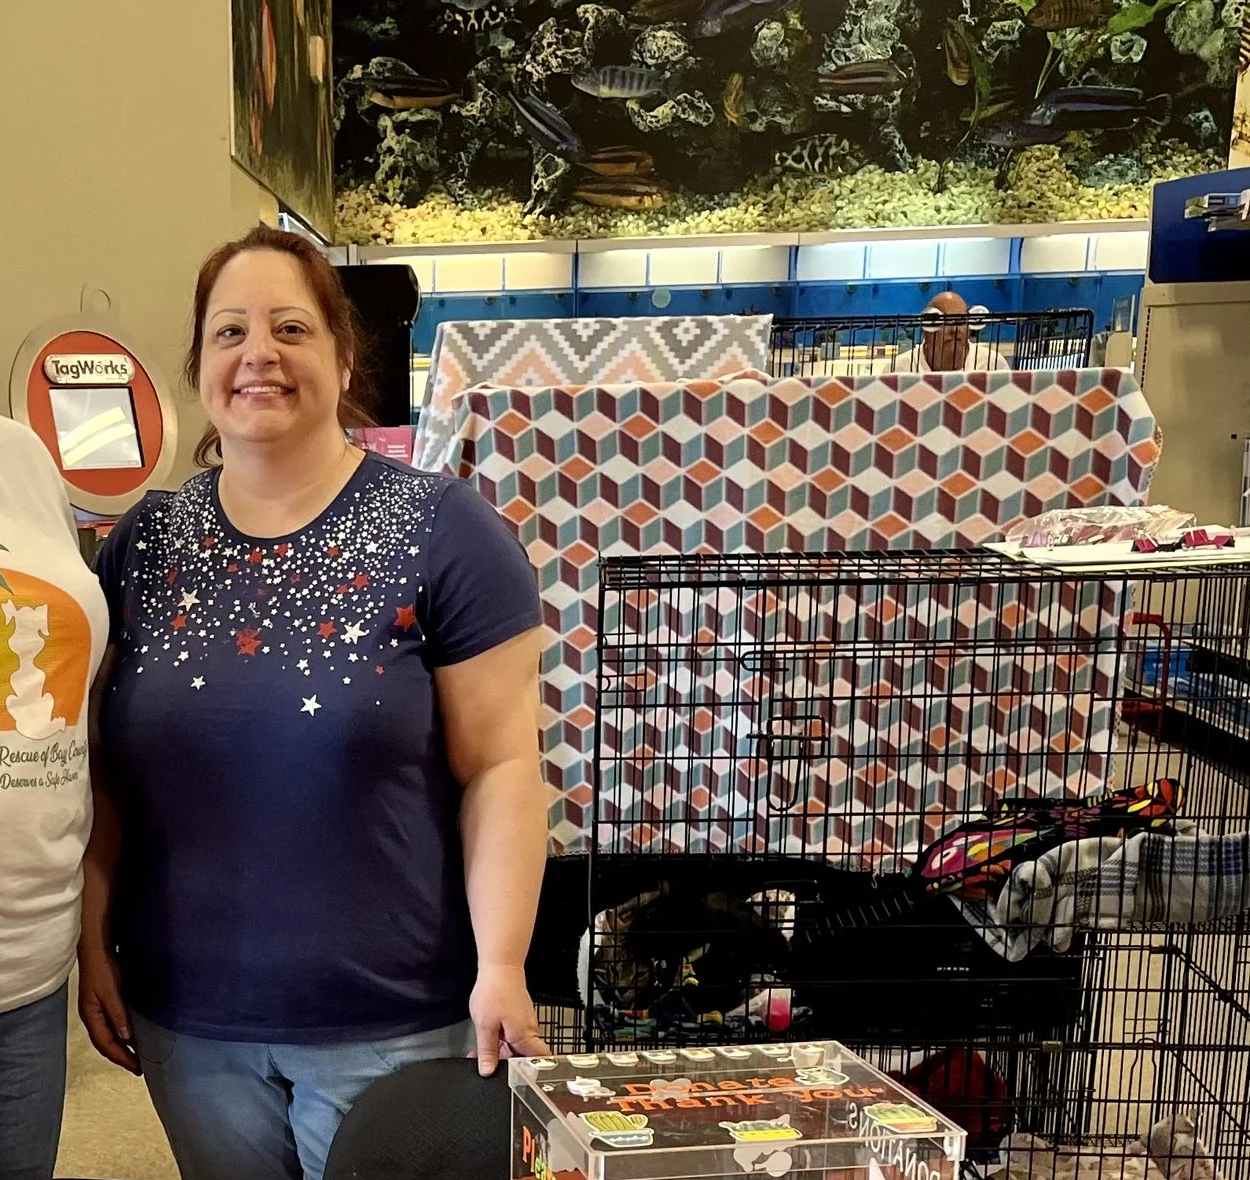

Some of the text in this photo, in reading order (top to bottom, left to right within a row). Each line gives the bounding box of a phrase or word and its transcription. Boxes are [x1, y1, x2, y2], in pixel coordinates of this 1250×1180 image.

[52, 359, 128, 380] TagWorks
[0, 772, 38, 790] Deserves
[610, 1093, 774, 1113] Thank
